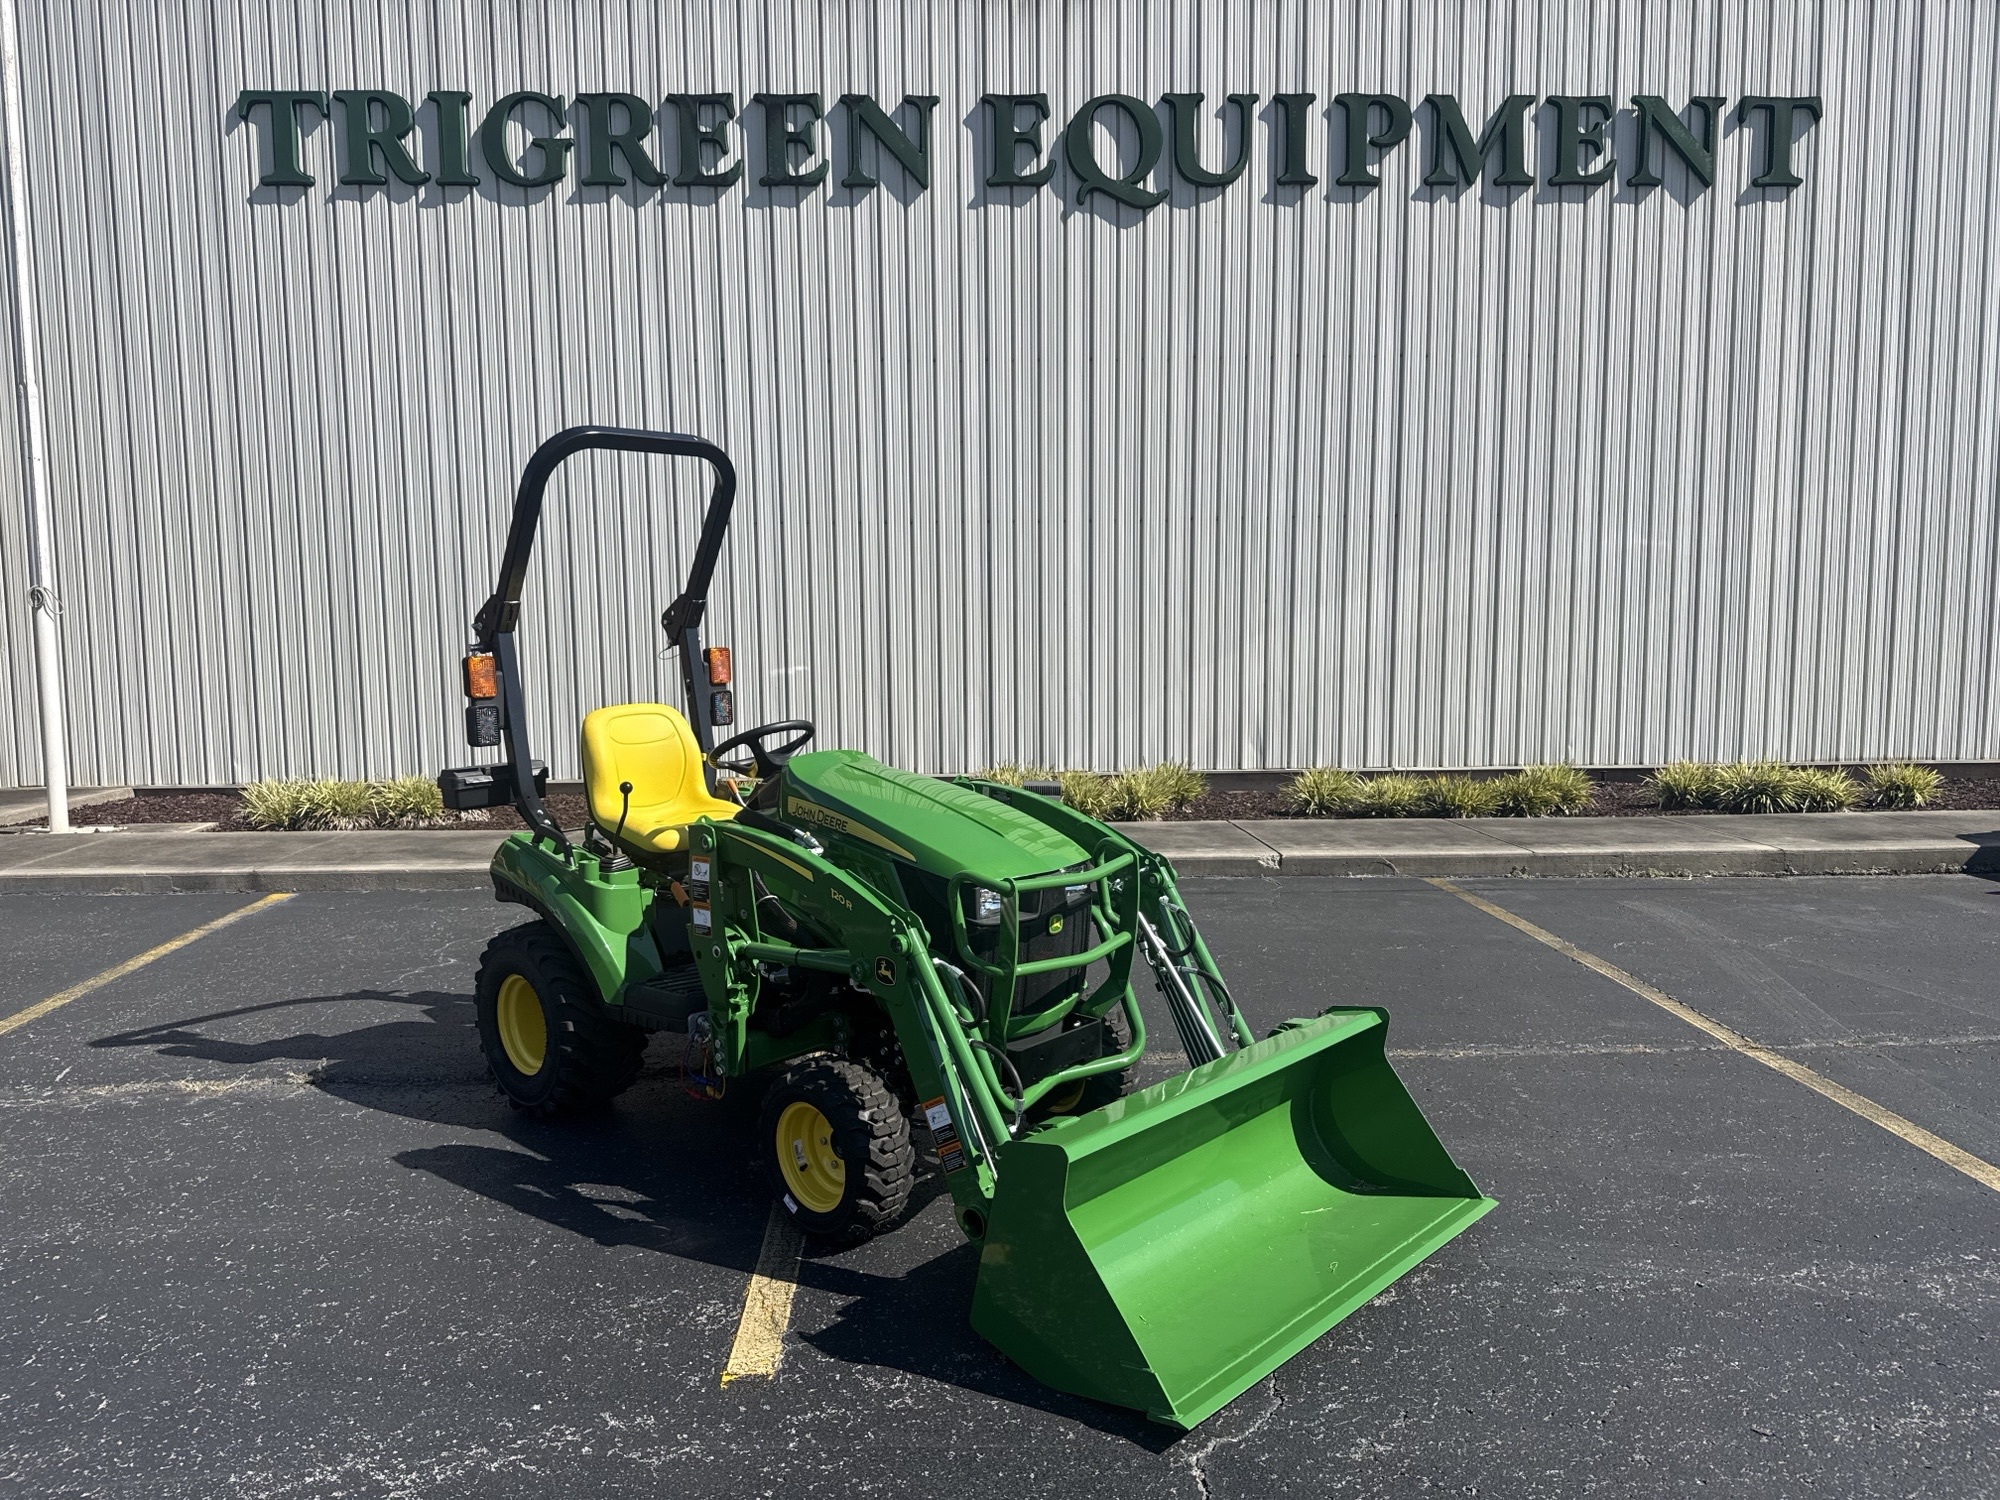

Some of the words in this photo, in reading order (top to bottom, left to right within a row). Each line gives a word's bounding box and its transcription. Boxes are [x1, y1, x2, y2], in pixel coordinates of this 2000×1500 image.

[239, 90, 940, 189] TRIGREEN
[981, 91, 1823, 207] EQUIPMENT
[792, 803, 816, 821] JOHN
[816, 810, 848, 832] DEERE
